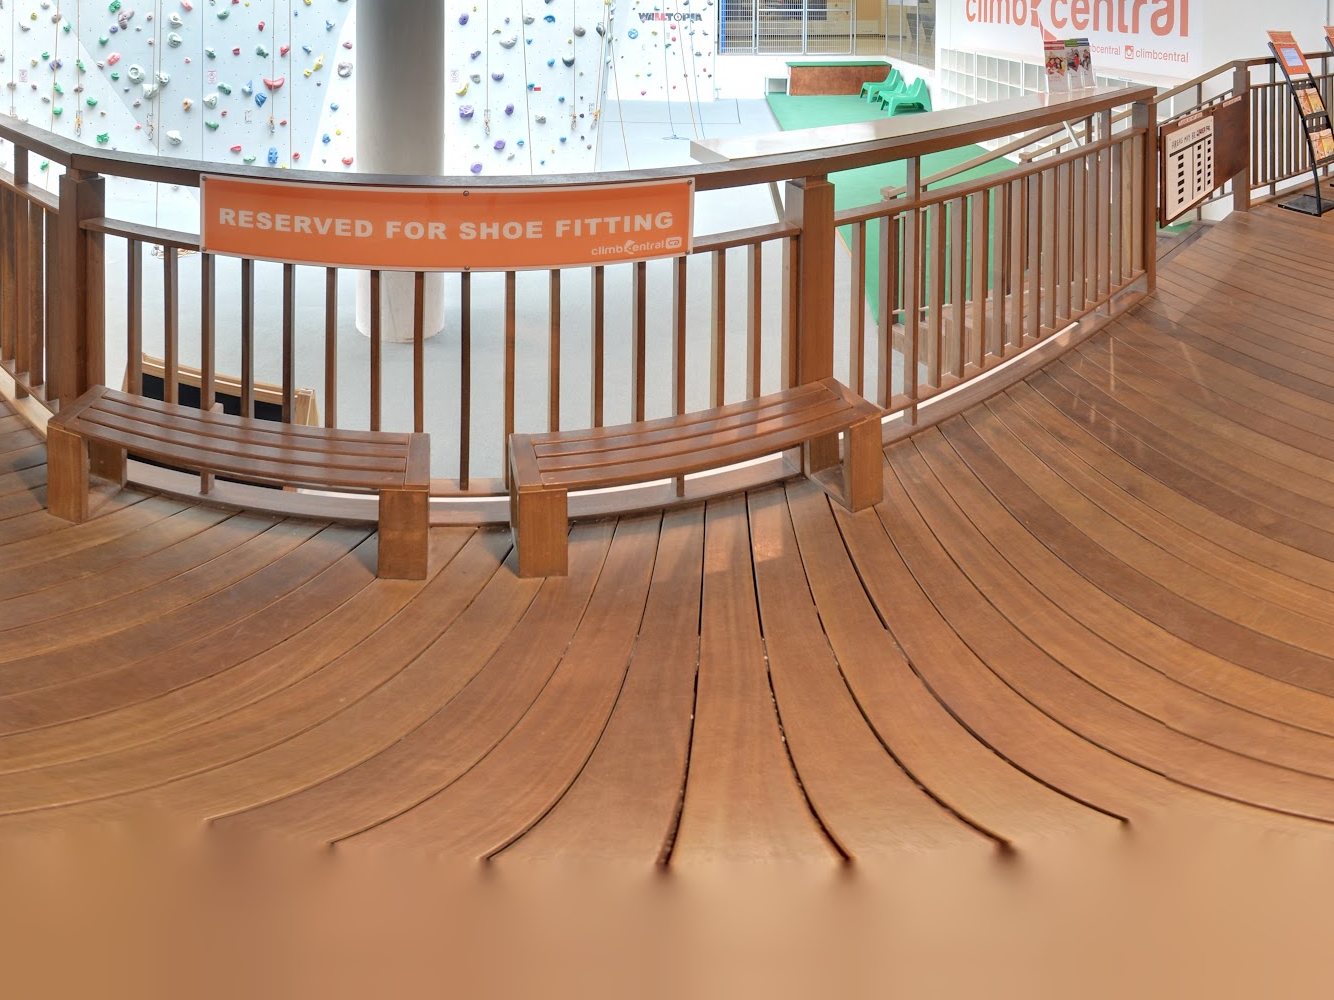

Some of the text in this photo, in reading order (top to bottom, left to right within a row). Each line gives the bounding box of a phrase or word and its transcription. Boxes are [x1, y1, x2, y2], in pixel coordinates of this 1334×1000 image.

[639, 13, 702, 21] WALLTOPIA
[1136, 50, 1189, 62] climbcentral
[219, 208, 674, 240] RESERVED FOR SHOE FITTING
